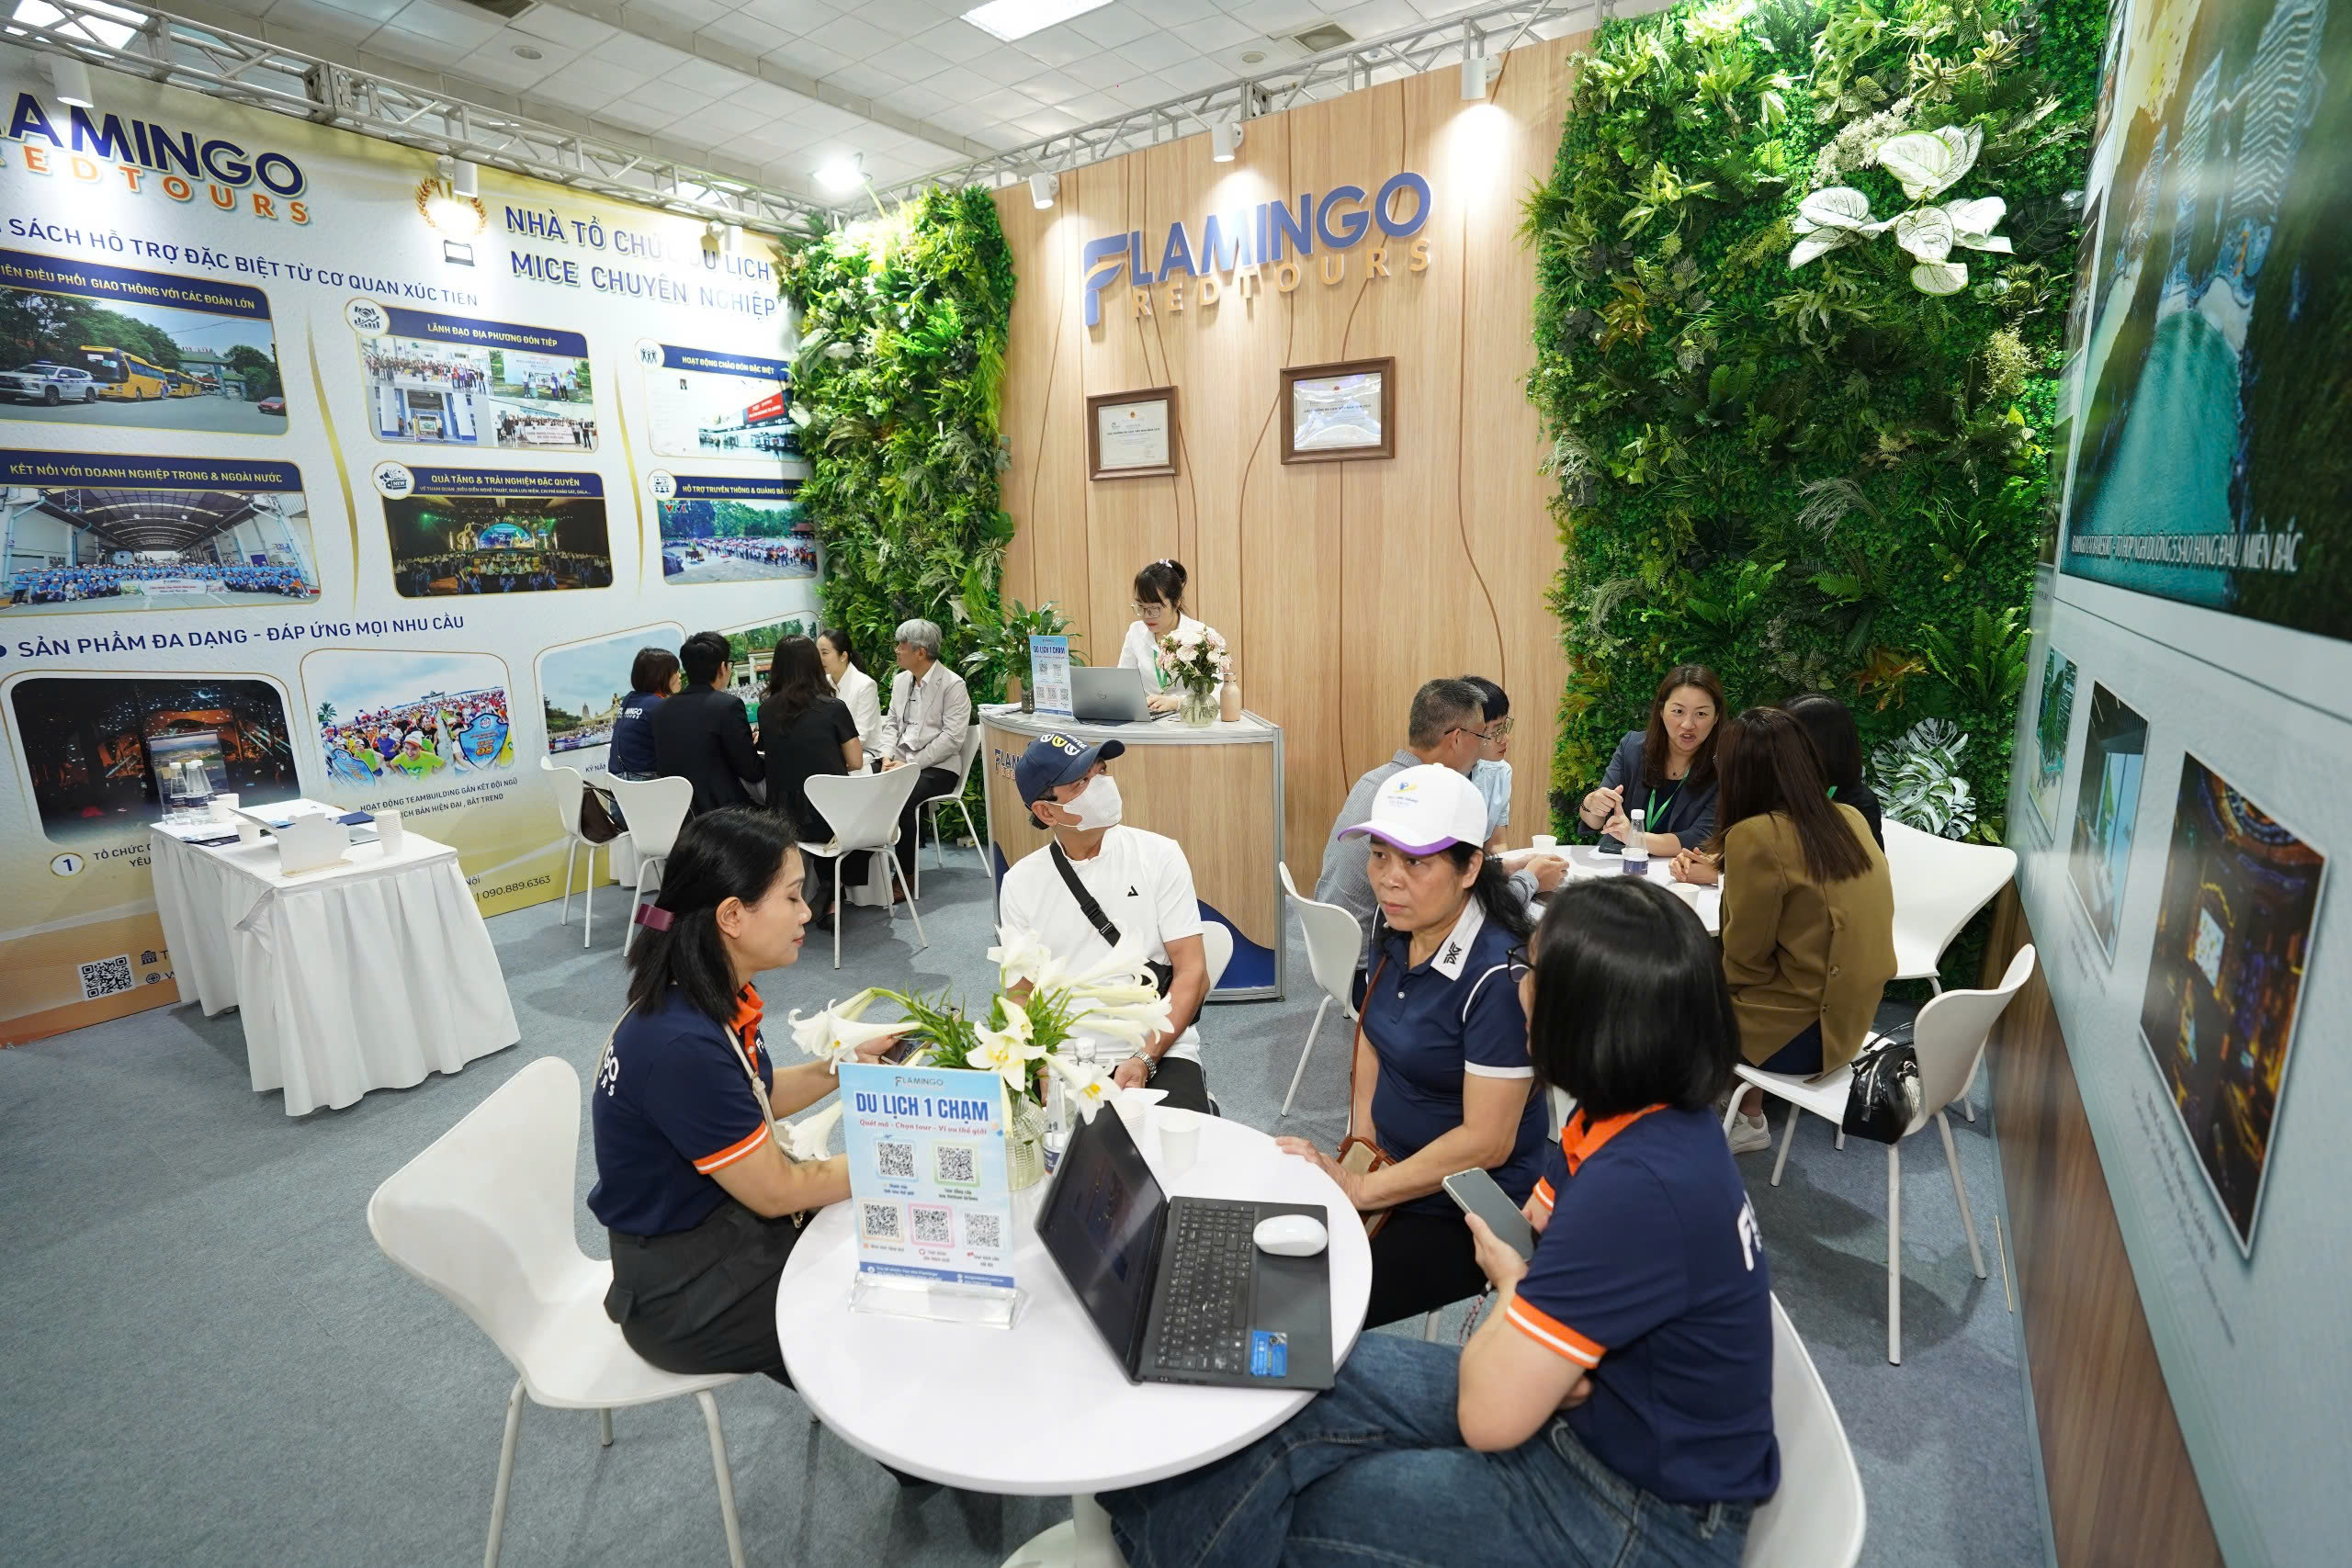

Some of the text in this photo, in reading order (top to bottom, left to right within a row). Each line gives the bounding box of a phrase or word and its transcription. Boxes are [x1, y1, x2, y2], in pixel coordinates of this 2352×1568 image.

[0, 92, 304, 196] AMINGO
[0, 144, 309, 224] EDTOURS
[8, 218, 82, 245] SÁCH
[89, 230, 124, 252] HỖ
[130, 239, 179, 264] TRỢ
[185, 246, 229, 270] ĐẶC
[236, 255, 280, 279] BIỆT
[285, 263, 313, 282] TỪ
[318, 269, 344, 287] CƠ
[349, 275, 399, 296] QUAN
[404, 280, 437, 301] XÚC
[505, 206, 565, 241] NHÀ
[571, 215, 605, 248] TỔ
[726, 254, 770, 283] LỊCH
[1084, 172, 1431, 325] FLAMINGO
[25, 267, 54, 282] ĐIỀU
[57, 272, 86, 287] PHỐI
[91, 278, 119, 291] GIAO
[120, 282, 160, 297] THÔNG
[161, 288, 180, 299] VỚI
[182, 290, 203, 302] CÁC
[204, 293, 233, 307] ĐOÀN
[234, 298, 255, 310] LỚN
[511, 251, 775, 321] MICE CHUYÊN NGHIỆP
[1131, 239, 1431, 318] REDTOURS
[427, 321, 451, 334] LÃNH
[452, 325, 469, 338] ĐẠO
[472, 329, 487, 341] ĐỊA
[488, 331, 522, 344] PHƯƠNG
[523, 335, 539, 345] ĐÓN
[10, 461, 282, 482] KẾT NỐI VỚI DOANH NGHIỆP TRONG & NGOÀI NƯỚC
[431, 474, 450, 484] QUÀ
[451, 474, 474, 485] TẶNG
[477, 476, 482, 484] &
[505, 476, 536, 487] NGHIỆM
[537, 476, 553, 487] ĐẶC
[17, 636, 71, 658] SẢN
[77, 631, 146, 654] PHẨM
[153, 633, 184, 649] ĐA
[188, 628, 247, 649] DẠNG
[266, 623, 305, 641] ĐÁP
[310, 620, 351, 637] ỨNG
[356, 620, 388, 637] MỌI
[392, 617, 428, 632] NHU
[432, 612, 464, 629] CẦU
[360, 800, 382, 813] HOẠT
[382, 797, 405, 809] ĐỘNG
[405, 788, 460, 804] TEAMBUILDING
[491, 780, 503, 790] ĐỘI
[401, 808, 414, 820] ỊCH
[450, 800, 462, 811] ĐẠI
[481, 793, 504, 805] TREND
[62, 858, 74, 872] 1
[94, 849, 109, 861] TỔ
[112, 844, 144, 857] CHỨC
[130, 856, 151, 867] YÊU
[482, 875, 551, 899] 090.889.6363
[895, 1076, 944, 1088] FLAMINGO
[855, 1092, 989, 1124] DU LỊCH 1 CHẠM
